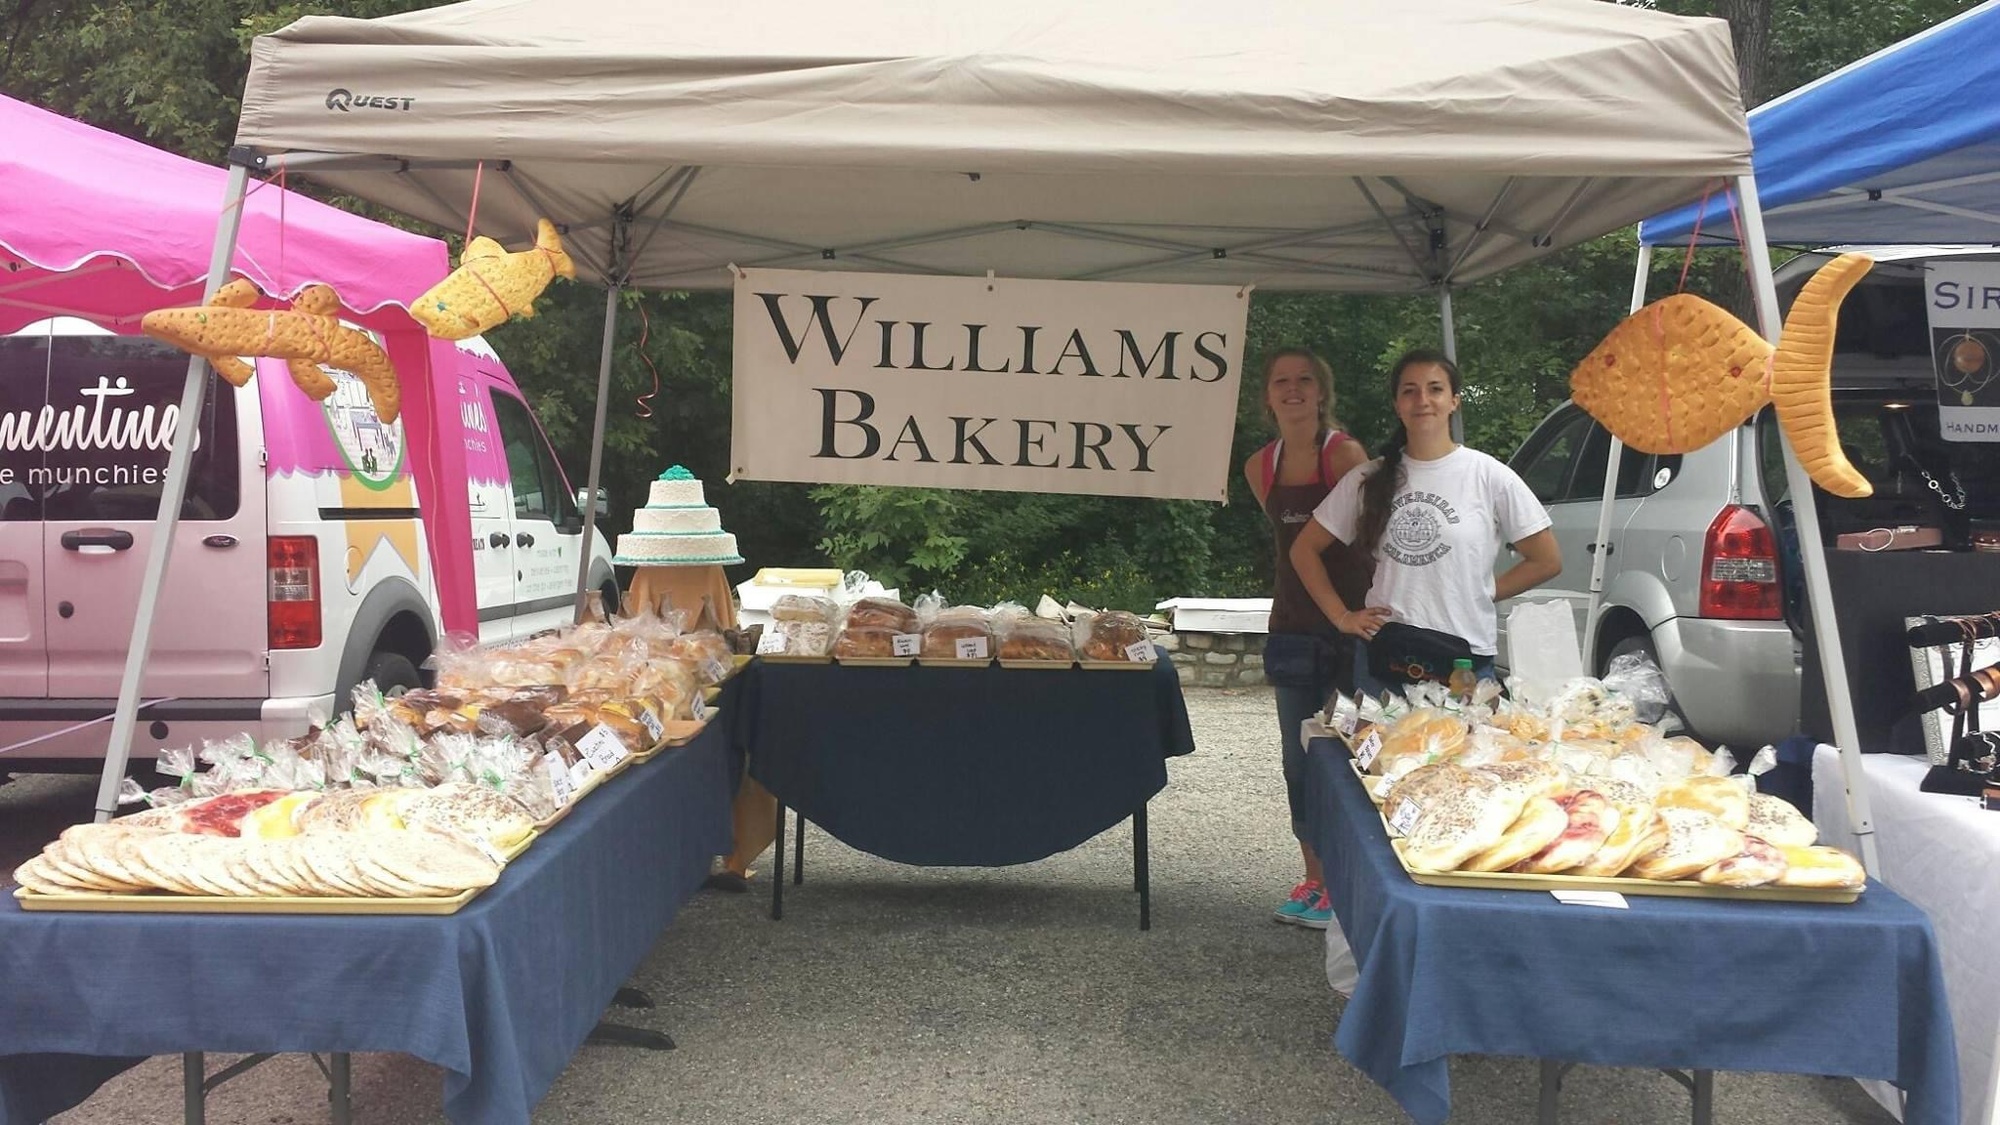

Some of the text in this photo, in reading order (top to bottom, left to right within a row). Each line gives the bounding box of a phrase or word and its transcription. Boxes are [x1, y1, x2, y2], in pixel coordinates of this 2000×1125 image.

[325, 88, 415, 112] QUEST
[1934, 281, 2000, 310] SIR
[752, 292, 1228, 383] WILLIAMS
[810, 388, 1172, 472] BAKERY
